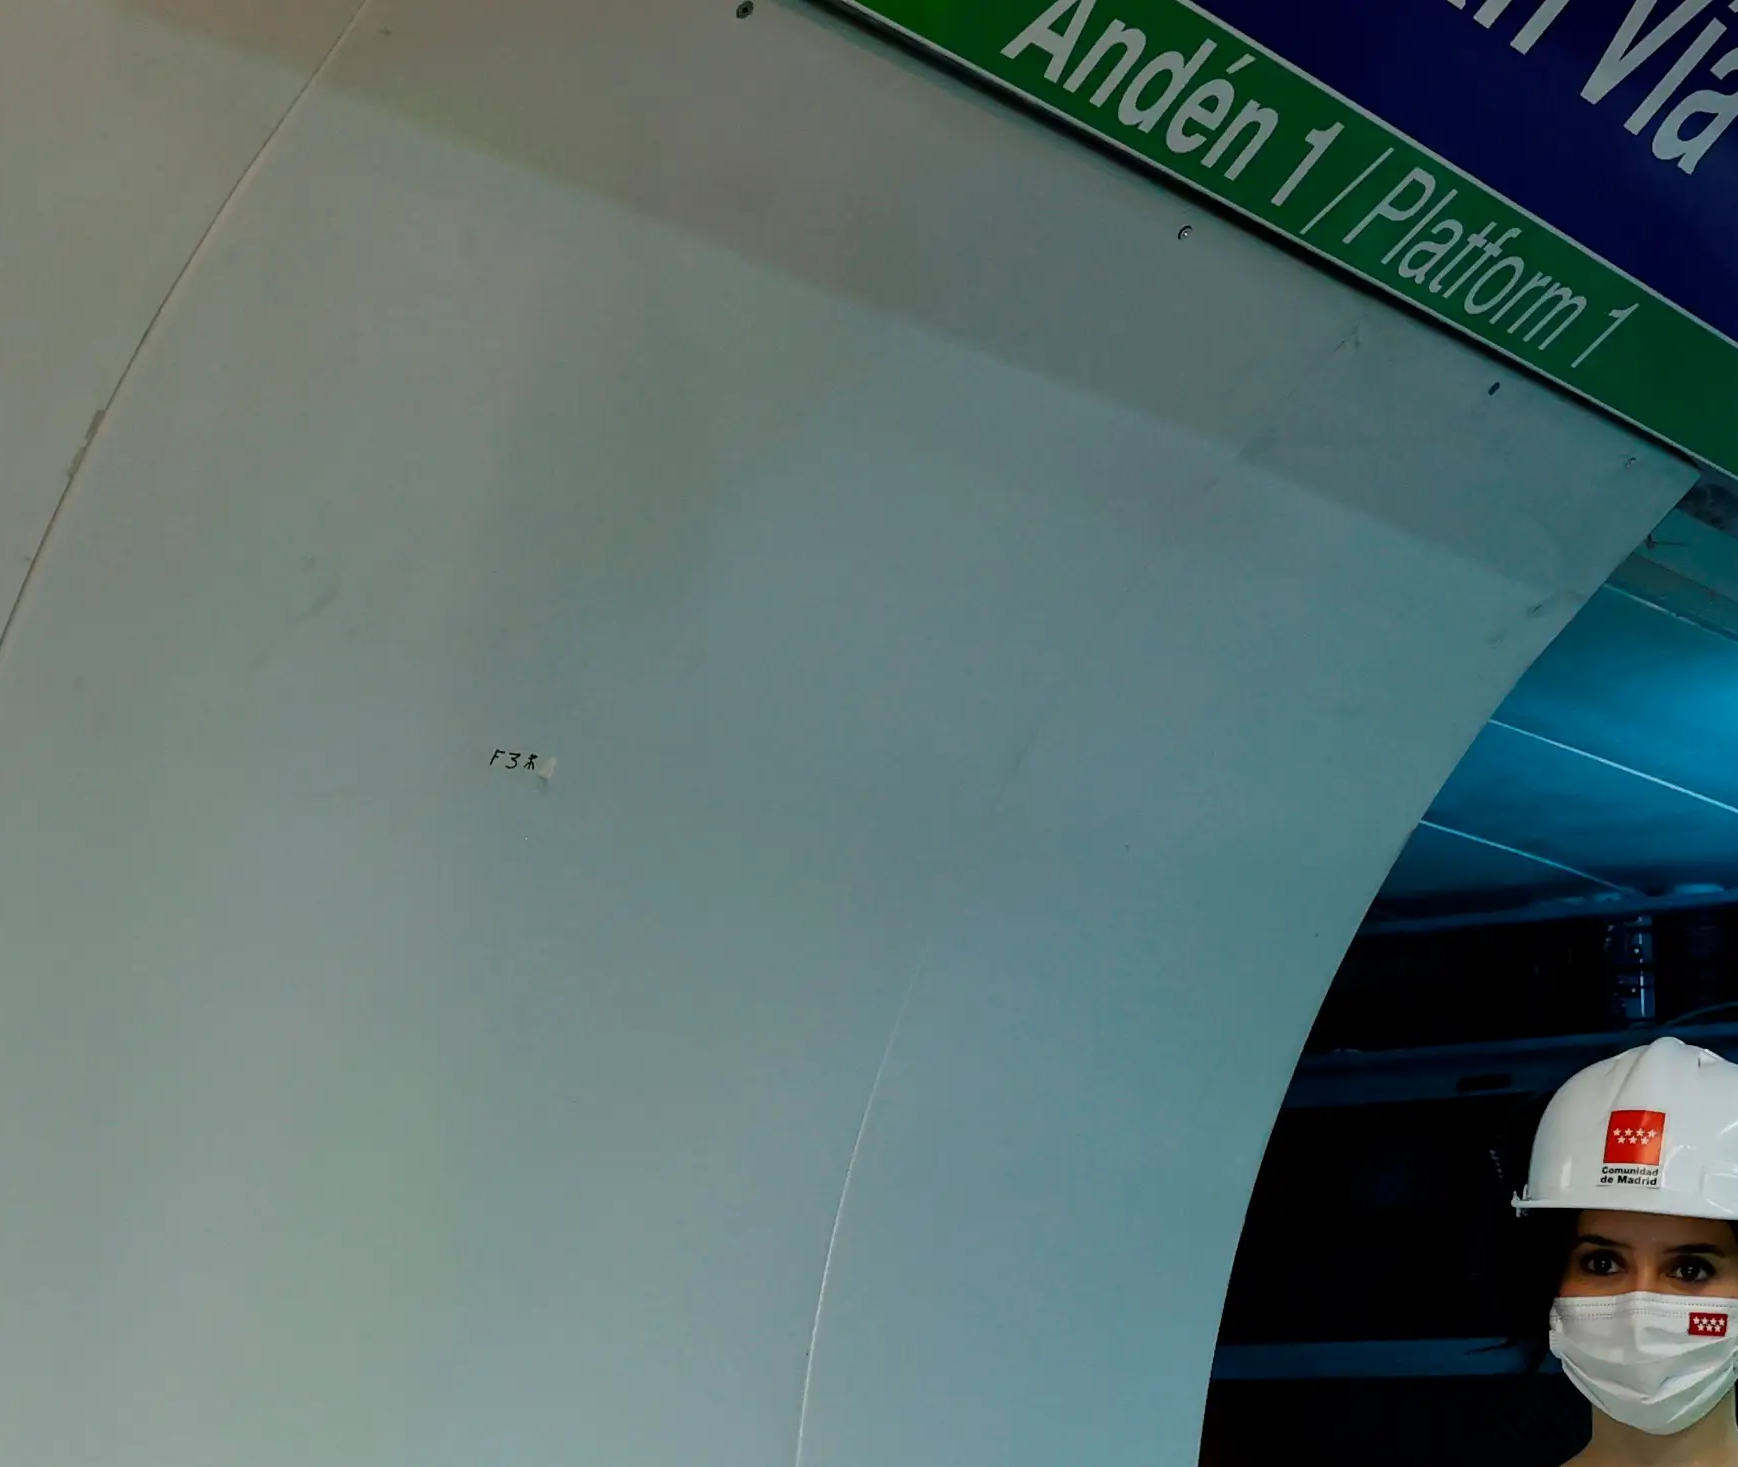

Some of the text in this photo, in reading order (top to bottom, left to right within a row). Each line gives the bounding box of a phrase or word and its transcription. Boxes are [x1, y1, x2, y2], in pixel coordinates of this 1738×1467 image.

[999, 0, 1279, 182] Andén
[1270, 121, 1345, 207] 1
[1342, 166, 1588, 351] Platform
[1570, 303, 1640, 369] 1
[1601, 1166, 1659, 1176] Comunidad
[1600, 1175, 1658, 1186] de Madrid
